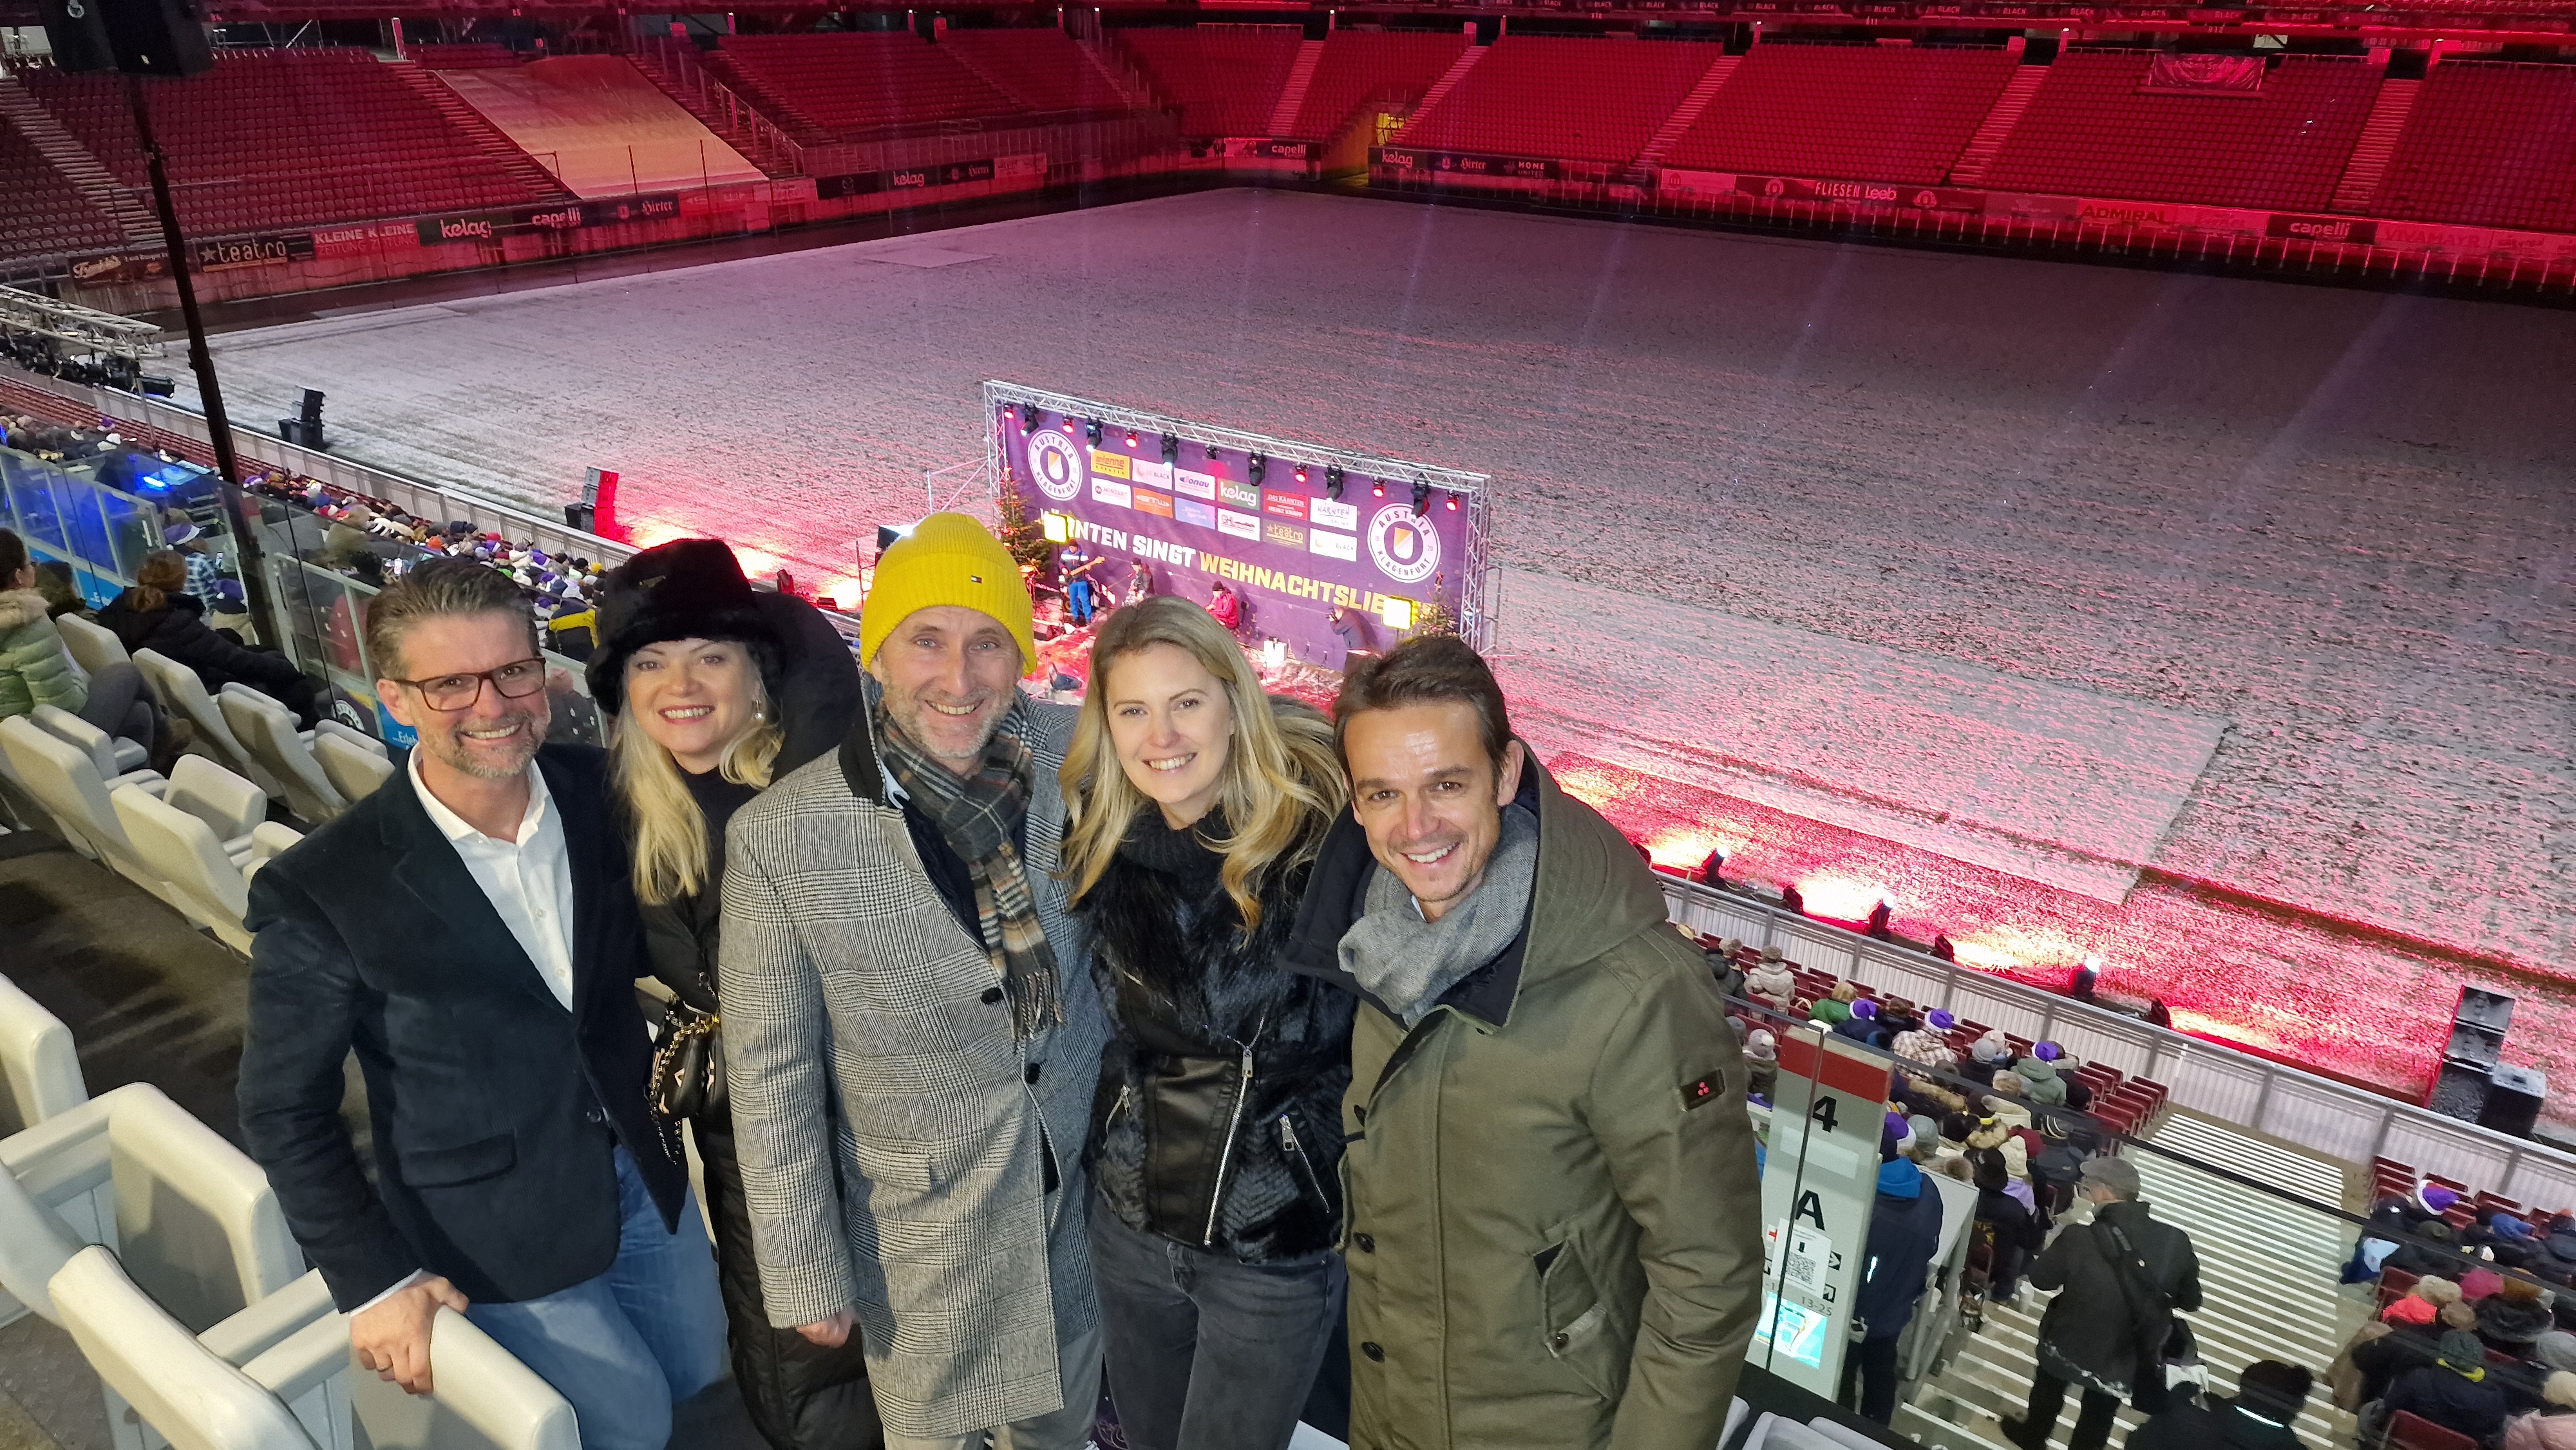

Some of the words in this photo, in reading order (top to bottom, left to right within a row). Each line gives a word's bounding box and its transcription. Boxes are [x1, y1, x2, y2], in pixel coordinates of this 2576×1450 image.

[1271, 144, 1306, 157] capelli
[1381, 149, 1414, 168] kelag
[1518, 161, 1544, 170] HOME
[893, 170, 925, 187] kelag
[1815, 182, 1861, 197] FLIESEN
[1864, 185, 1897, 201] Leeb
[642, 201, 673, 214] Hirter
[2079, 204, 2171, 223] ADMIRAL
[315, 229, 363, 244] KLEINE
[440, 219, 491, 239] kelag
[2289, 221, 2351, 238] capelli
[217, 238, 287, 263] teatro
[317, 240, 366, 254] ZEITUNG
[1034, 435, 1074, 459] AUSTRIA
[1095, 455, 1124, 468] antenne
[1036, 471, 1075, 494] KLAGENFURT
[1153, 471, 1170, 480] BLACK
[1220, 481, 1257, 507] kelag
[1274, 523, 1303, 541] teatro
[1039, 507, 1128, 551] RNTEN
[1133, 534, 1196, 567] SINGT
[1199, 552, 1437, 616] WEIHNACHTSLIE
[1378, 551, 1430, 576] KLAGENFURT
[1812, 1095, 1838, 1133] 4
[1794, 1190, 1826, 1231] A
[1801, 1296, 1832, 1317] 13-25
